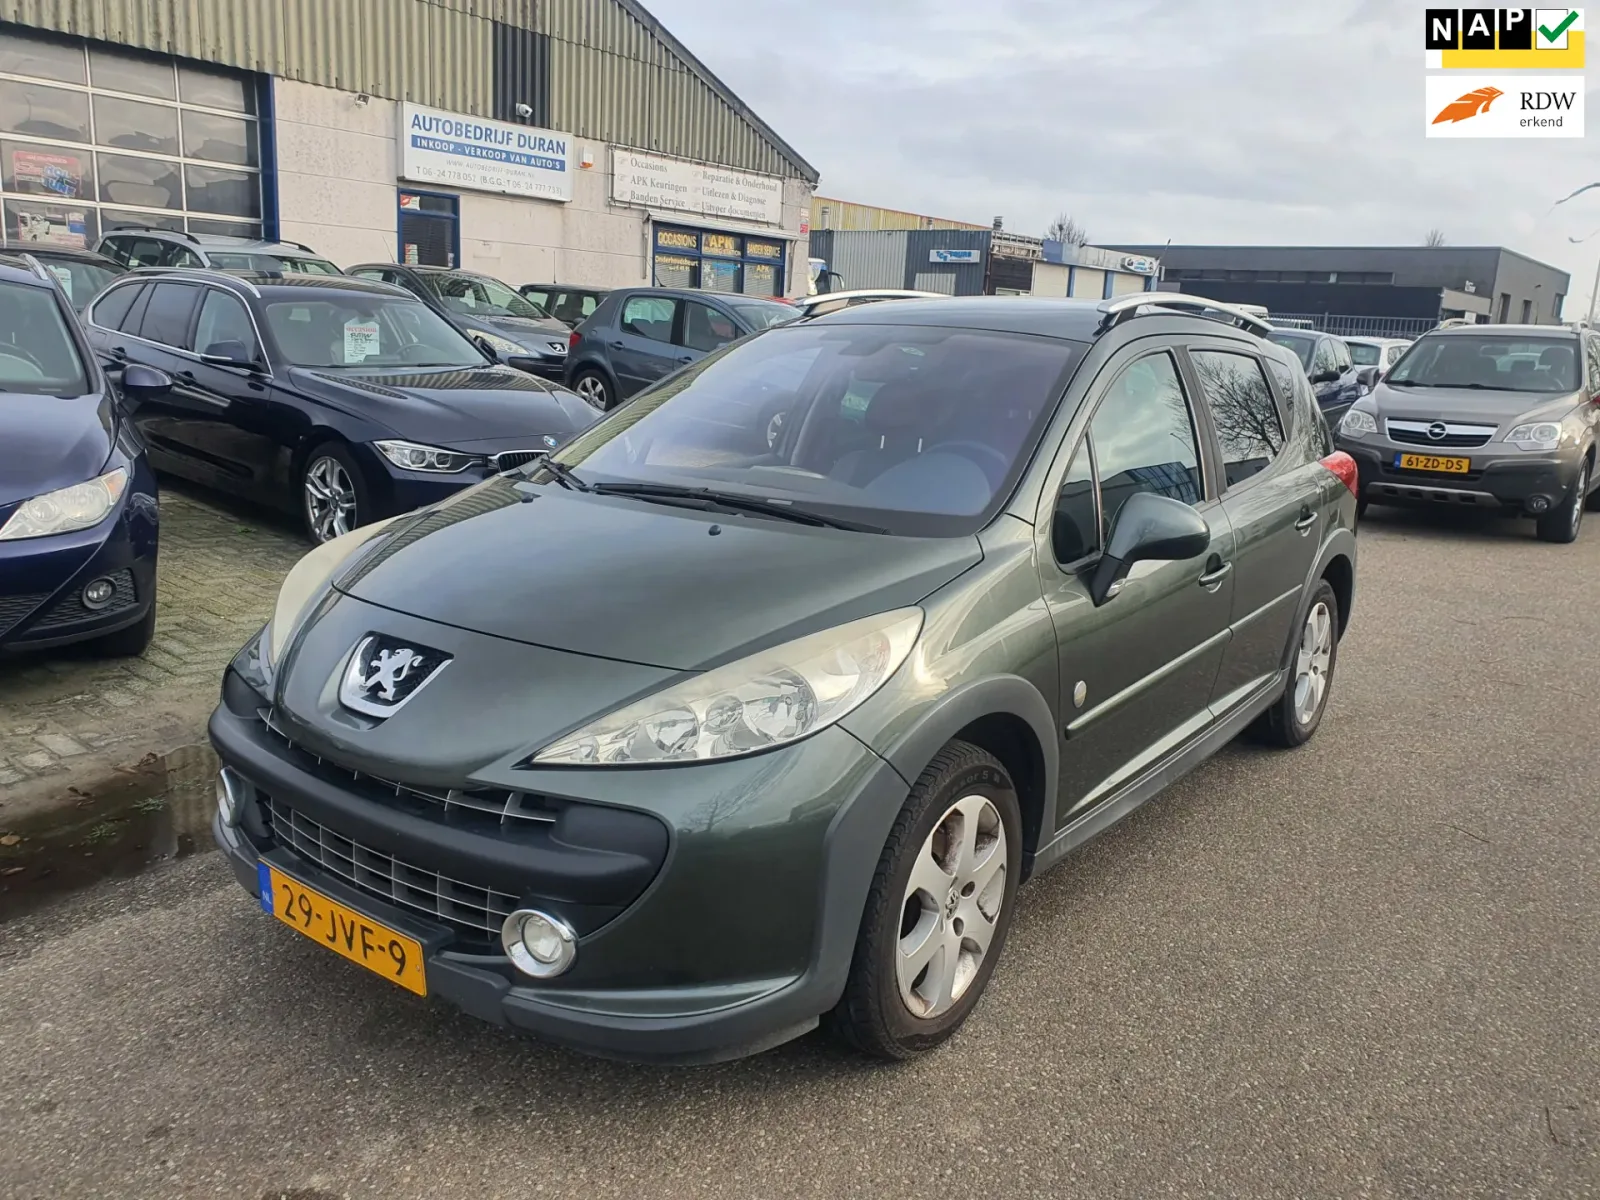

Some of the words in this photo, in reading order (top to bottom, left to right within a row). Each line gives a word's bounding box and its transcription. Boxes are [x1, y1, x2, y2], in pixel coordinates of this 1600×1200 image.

[411, 114, 513, 146] AUTOBEDRIJF
[517, 134, 566, 155] DURAN
[417, 137, 455, 151] INKOOP
[464, 146, 507, 160] VERKOOP
[509, 153, 527, 164] VAN
[530, 157, 560, 169] AUTO'S
[630, 158, 668, 172] Occasions
[630, 175, 648, 187] APK
[650, 178, 688, 193] Keuringen
[702, 171, 734, 184] Reparatie
[735, 177, 740, 185] &
[741, 177, 777, 192] Onderhoud
[630, 190, 659, 203] Banden
[660, 194, 686, 207] Service
[702, 187, 729, 200] Uitlezen
[731, 192, 736, 200] &
[738, 192, 767, 206] Diagnose
[658, 231, 697, 248] OCCASIONS
[709, 234, 735, 249] APK
[1406, 456, 1464, 471] 61-ZD-DS
[262, 889, 272, 904] NL
[282, 884, 406, 976] 29-JVF-9
